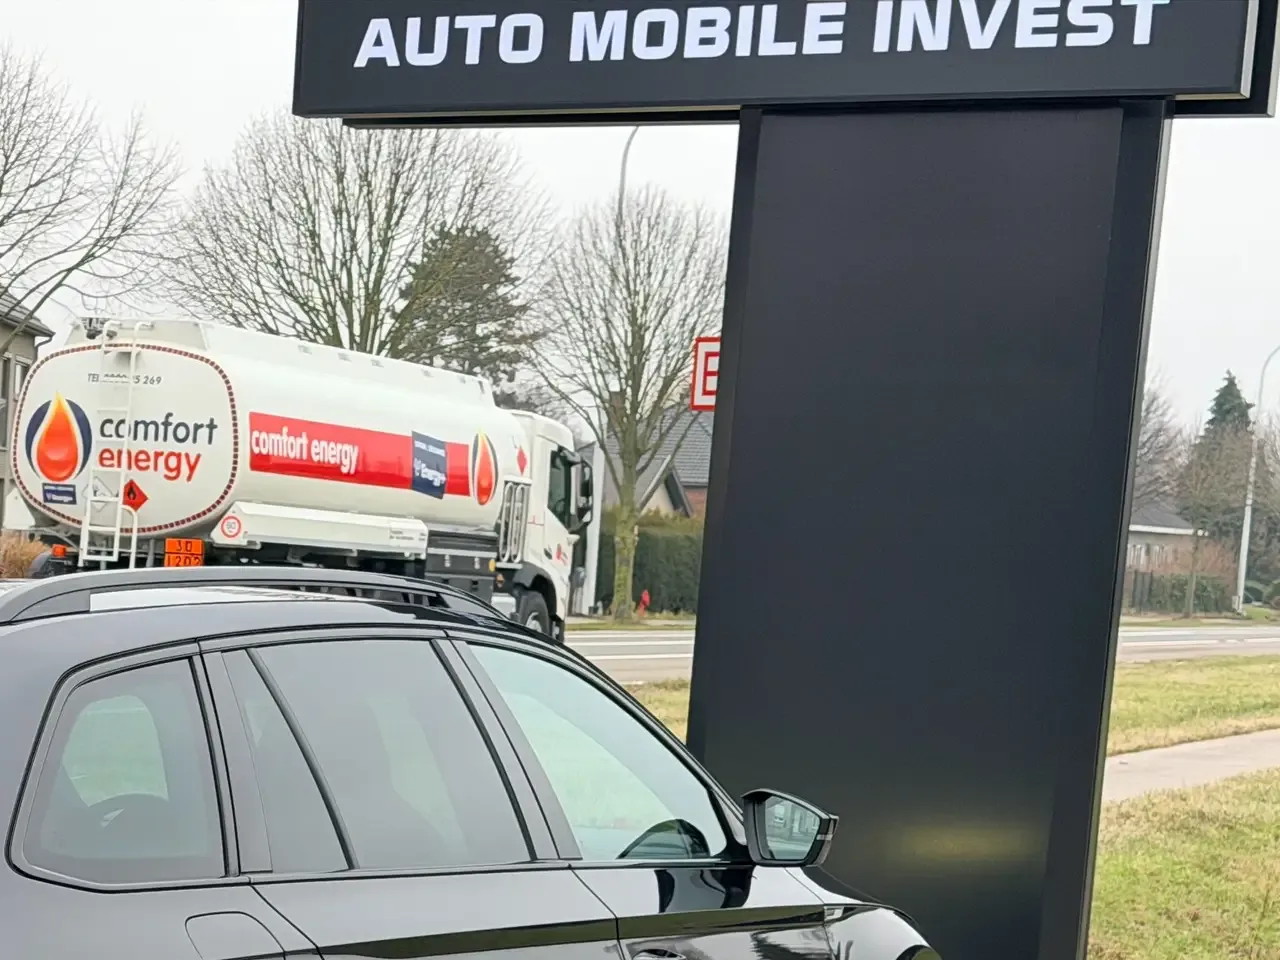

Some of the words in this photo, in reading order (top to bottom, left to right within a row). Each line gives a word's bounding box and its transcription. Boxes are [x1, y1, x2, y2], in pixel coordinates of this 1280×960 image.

[353, 13, 544, 68] AUTO
[569, 2, 847, 62] MOBILE
[873, 0, 1171, 53] INVEST
[99, 412, 218, 445] comfort
[98, 448, 202, 483] energy
[252, 426, 308, 461] comfort
[311, 438, 359, 474] energy
[175, 540, 193, 552] 30
